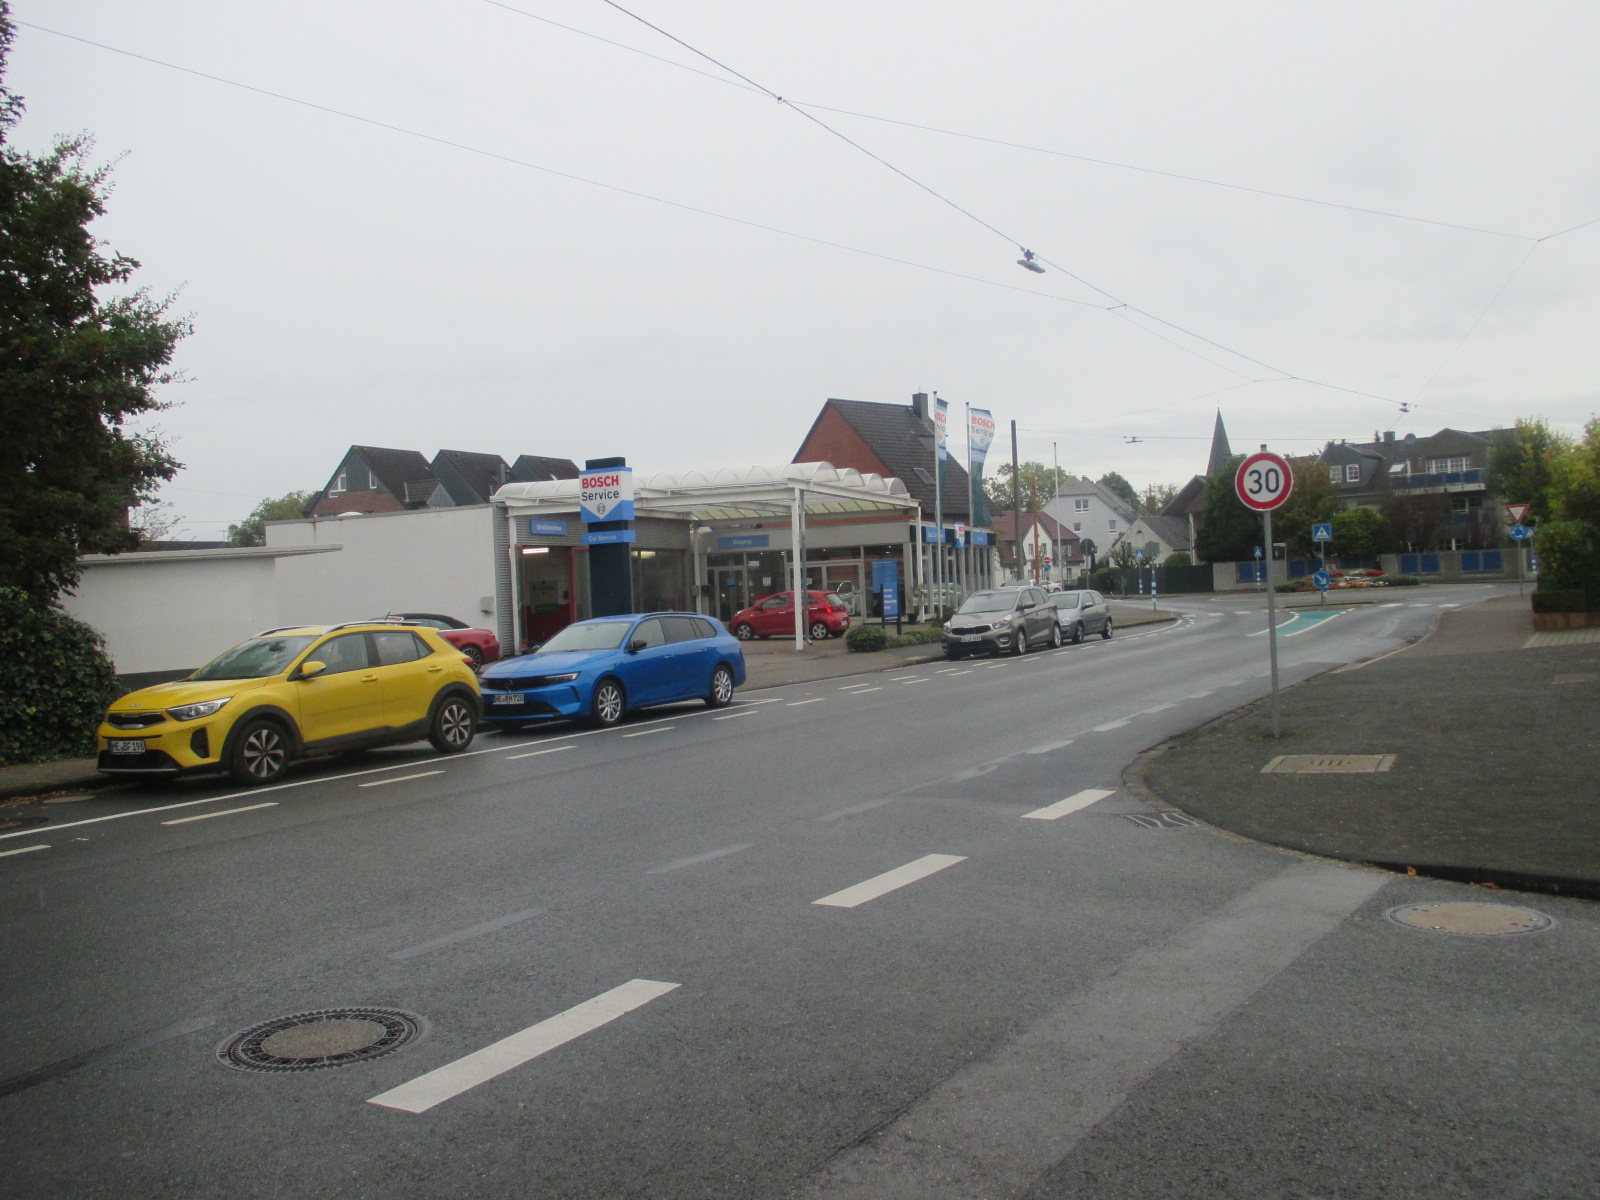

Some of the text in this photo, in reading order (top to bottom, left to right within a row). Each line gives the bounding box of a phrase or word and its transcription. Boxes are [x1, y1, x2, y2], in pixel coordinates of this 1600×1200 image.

[971, 416, 995, 429] BOSCH
[582, 475, 619, 489] BOSCH
[1248, 468, 1279, 494] 30
[581, 489, 619, 501] Service
